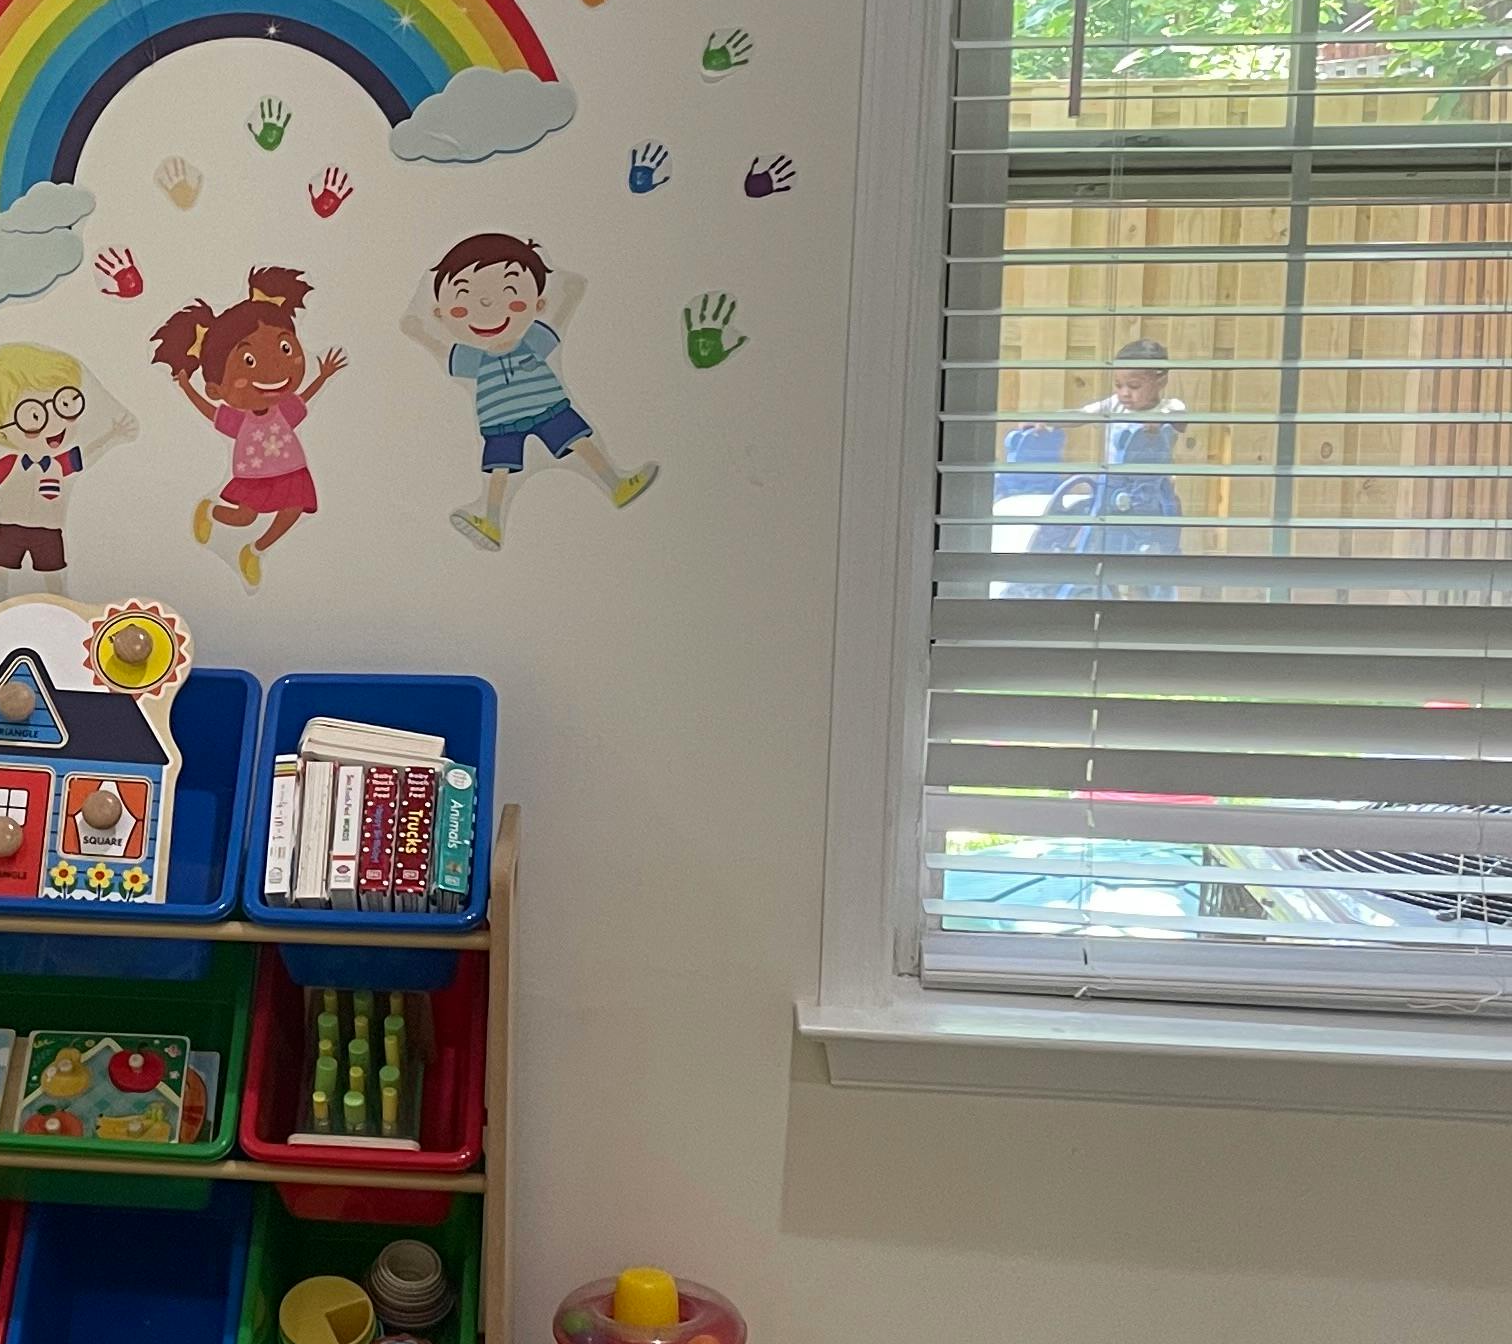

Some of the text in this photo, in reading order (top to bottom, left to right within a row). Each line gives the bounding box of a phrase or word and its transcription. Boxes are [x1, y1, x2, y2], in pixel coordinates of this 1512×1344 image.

[82, 836, 124, 847] SQUARE
[405, 809, 424, 854] Trucks
[447, 799, 465, 849] Animals
